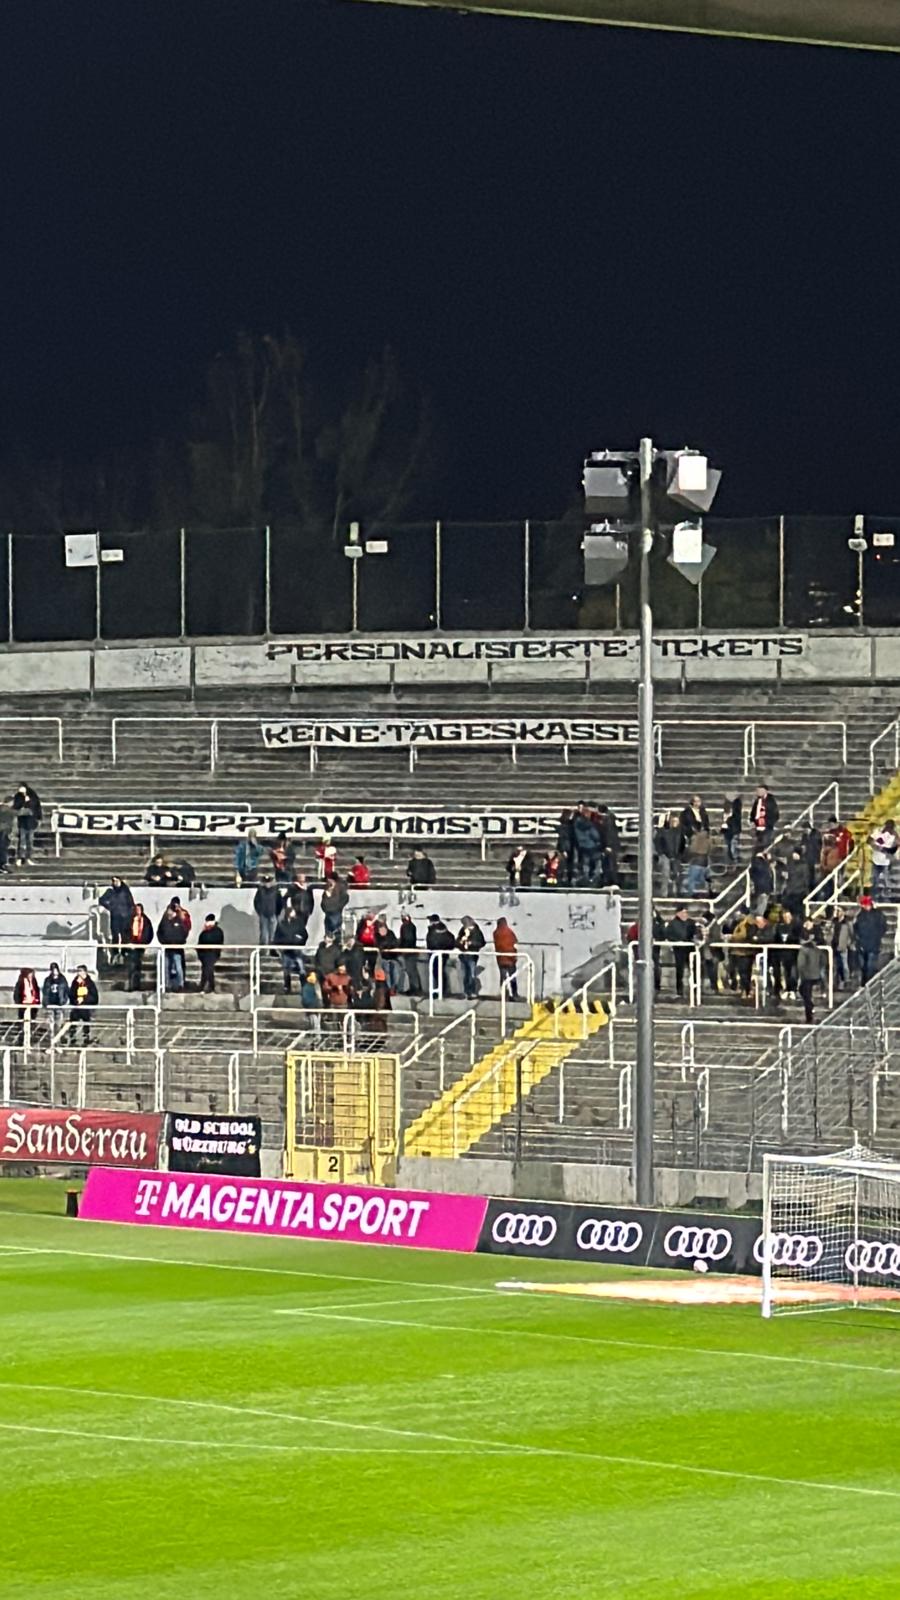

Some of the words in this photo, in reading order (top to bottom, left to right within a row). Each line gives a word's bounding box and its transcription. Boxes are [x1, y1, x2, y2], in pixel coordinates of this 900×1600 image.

[1, 1112, 147, 1160] Sanderau
[175, 1118, 201, 1134] OLD
[203, 1121, 256, 1136] SCHOOL
[328, 1156, 338, 1172] 2
[161, 1181, 315, 1229] MAGENTA
[319, 1193, 430, 1238] SPORT
